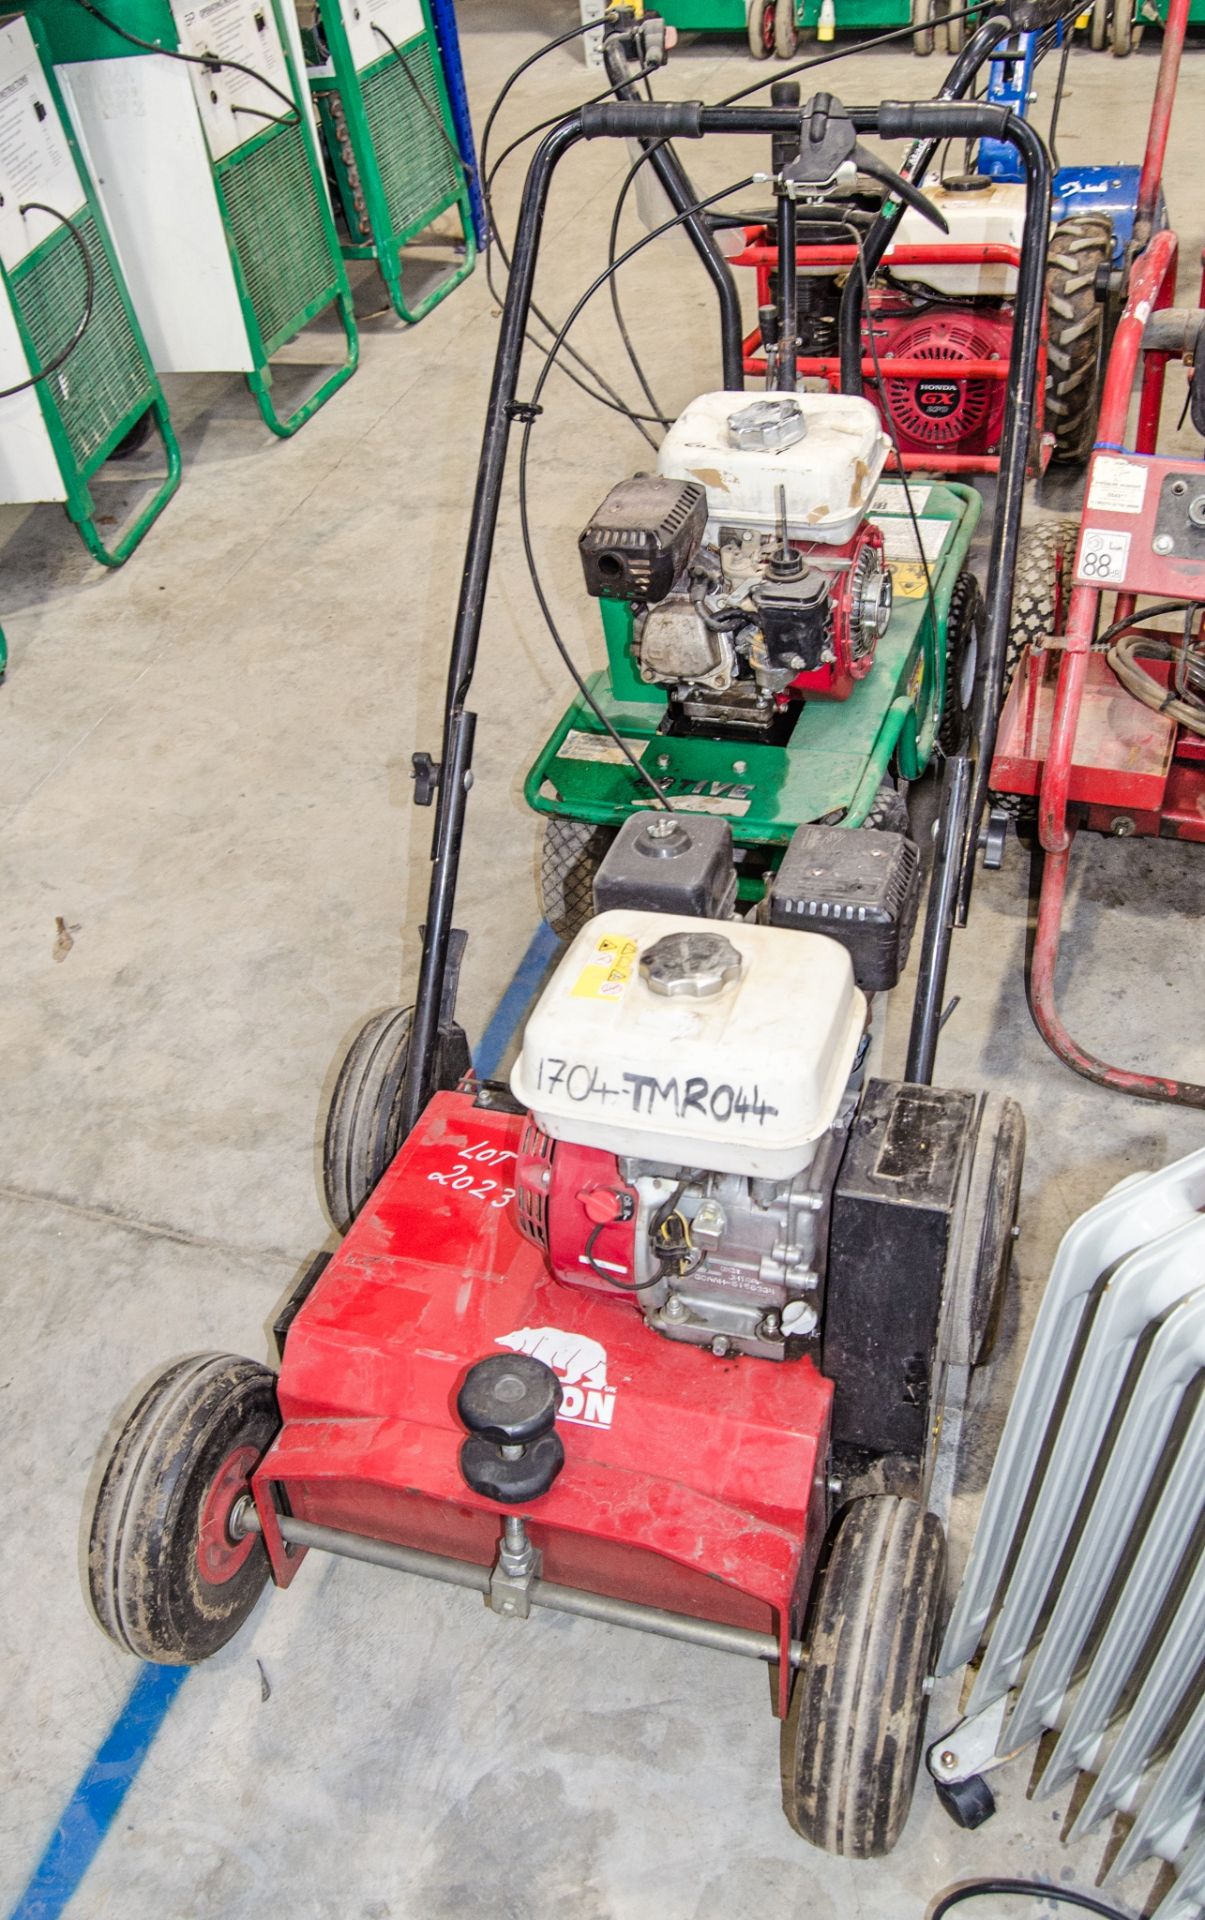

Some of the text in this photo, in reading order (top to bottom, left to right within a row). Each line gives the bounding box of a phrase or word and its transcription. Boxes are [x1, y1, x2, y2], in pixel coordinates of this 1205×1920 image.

[921, 392, 955, 405] GX
[1083, 552, 1111, 578] 88
[537, 1058, 779, 1126] 1704-TMR044
[457, 1140, 519, 1167] LOT
[427, 1164, 517, 1208] 2023
